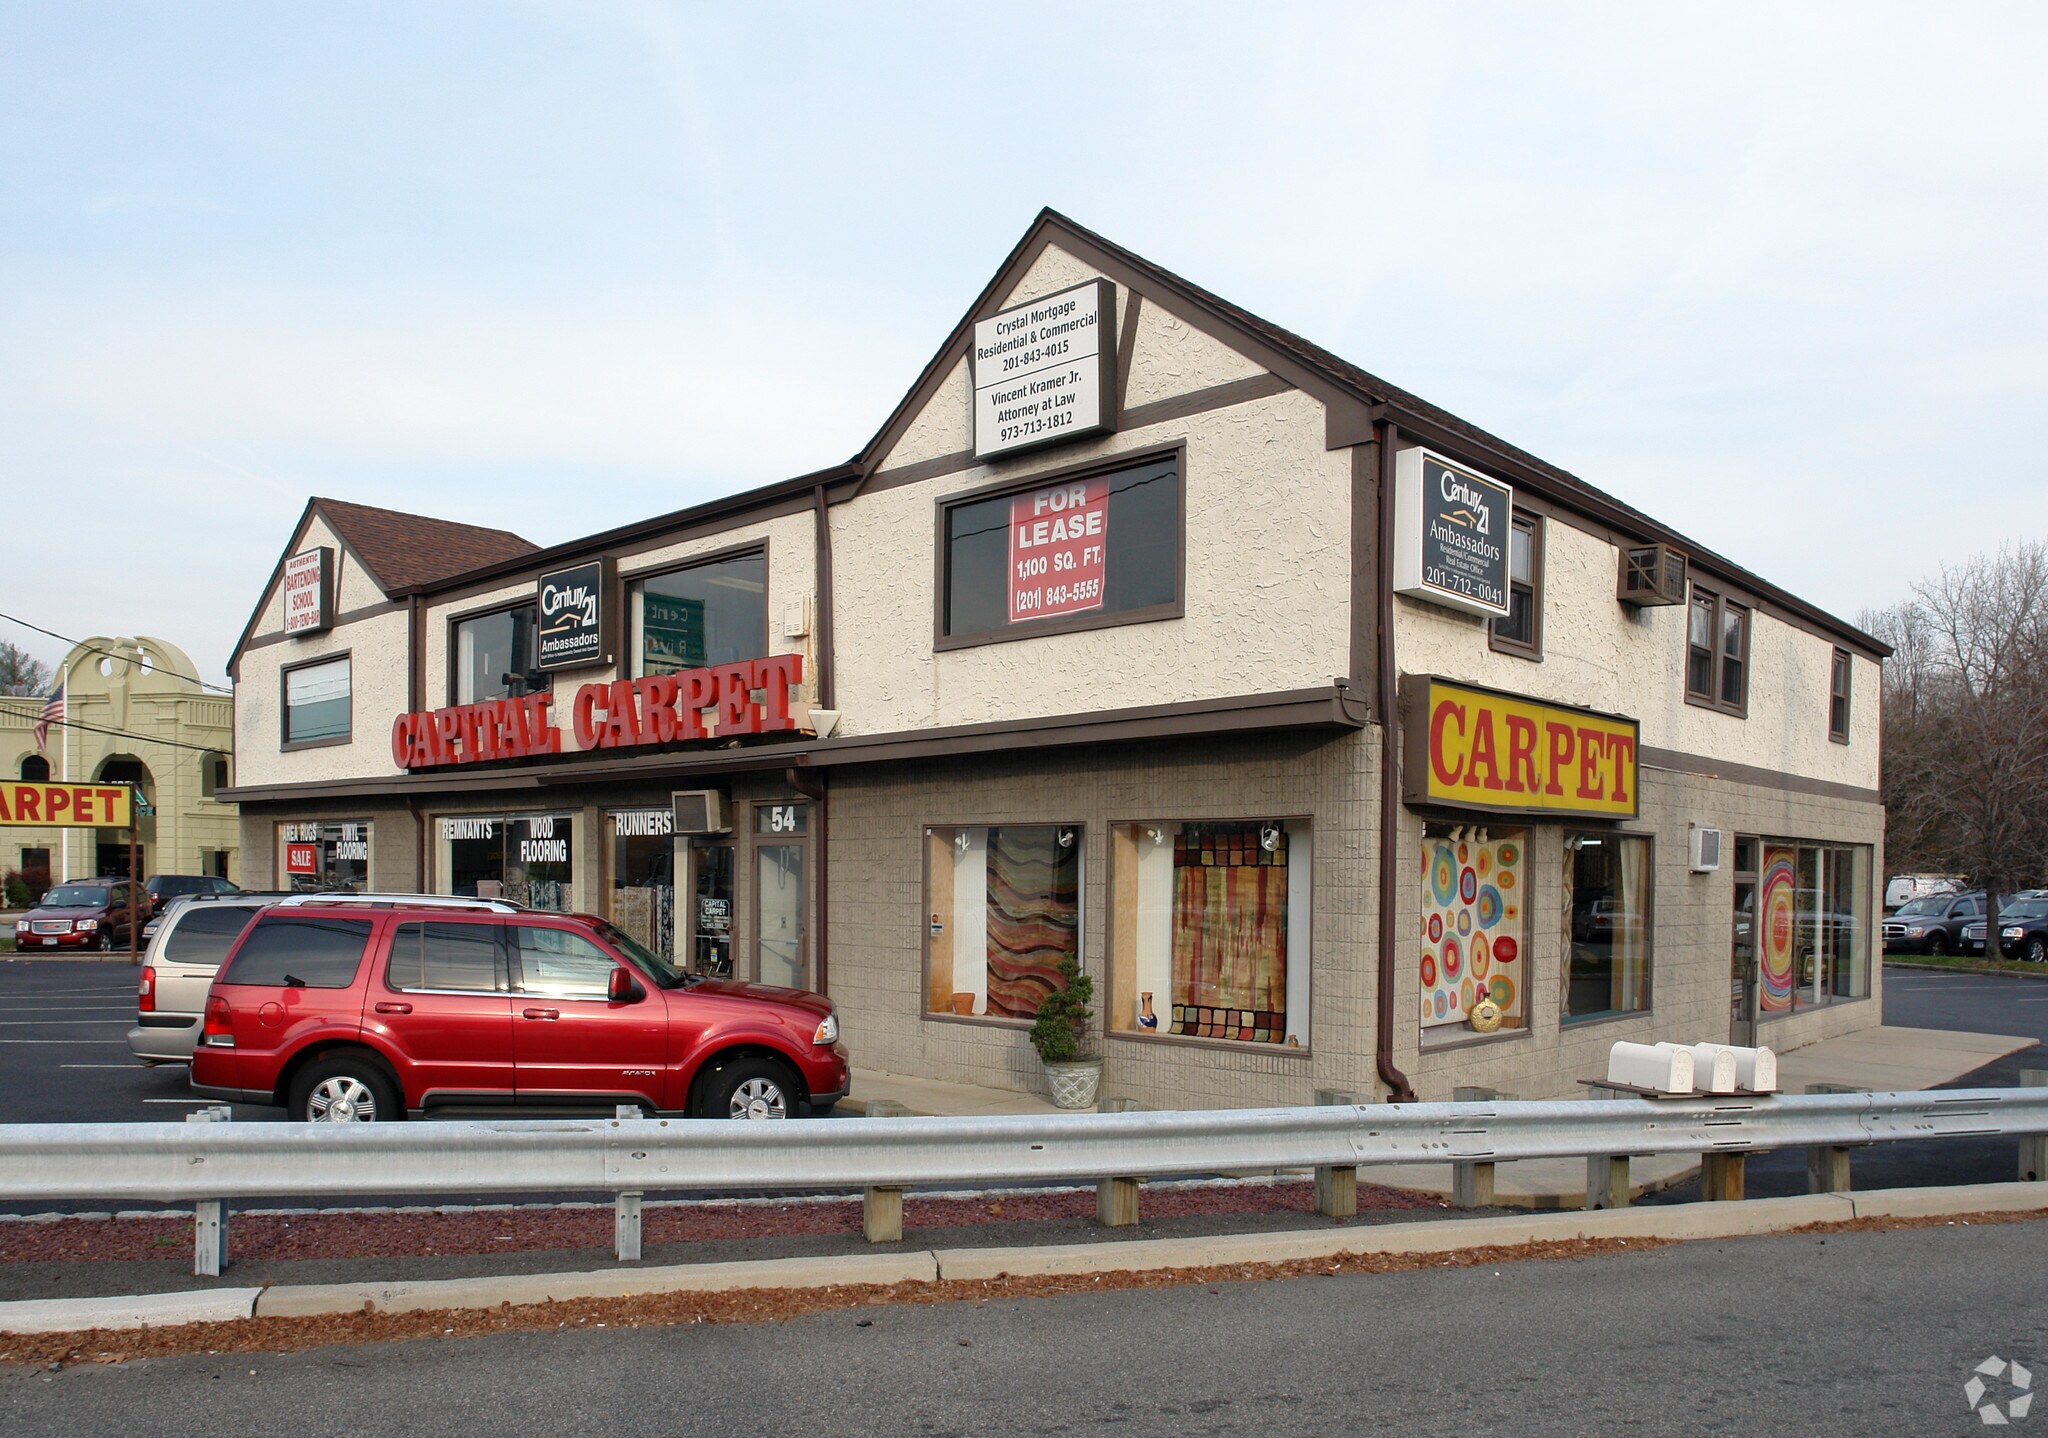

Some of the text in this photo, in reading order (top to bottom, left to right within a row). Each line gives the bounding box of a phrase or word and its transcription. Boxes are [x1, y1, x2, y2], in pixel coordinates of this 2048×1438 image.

[996, 299, 1076, 336] Crystal Mortgage
[977, 310, 1098, 361] Residential & Commercial
[1003, 339, 1069, 372] 201-843-4015
[991, 370, 1082, 407] Vincent Kramer Jr.
[997, 391, 1076, 424] Attorney at Law
[1000, 411, 1073, 442] 973-713-1812
[1033, 484, 1087, 516] FOR
[1440, 470, 1483, 513] Century
[1019, 510, 1102, 549] LEASE
[1476, 505, 1490, 535] 21
[1429, 519, 1500, 561] Ambassadors
[289, 553, 318, 570] AUTHENTIC
[1016, 545, 1102, 582] 1,100 SQ. FT.
[1445, 555, 1455, 566] Real
[1456, 558, 1470, 571] Estate
[1469, 562, 1484, 575] Office
[286, 565, 321, 591] BARTENDING
[1426, 566, 1503, 605] 201-712-0041
[292, 590, 314, 611] SCHOOL
[541, 584, 588, 616] Century
[1016, 577, 1100, 613] (201) 843-5555
[286, 611, 320, 631] 1-800-TEND-BAR
[581, 594, 597, 627] 21
[541, 632, 598, 653] Ambassadors
[392, 654, 803, 769] CAPITAL CARPET
[1429, 699, 1633, 804] CARPET
[282, 823, 318, 841] AREA RUGS
[341, 823, 359, 841] VINYL
[442, 818, 493, 840] REMNANTS
[530, 816, 554, 839] WOOD
[615, 810, 672, 836] RUNNERS
[771, 806, 796, 832] 54
[291, 850, 311, 867] SALE
[336, 841, 367, 860] FLOORING
[520, 839, 567, 862] FLOORING
[704, 900, 727, 908] CAPITAL
[704, 908, 726, 916] CARPET
